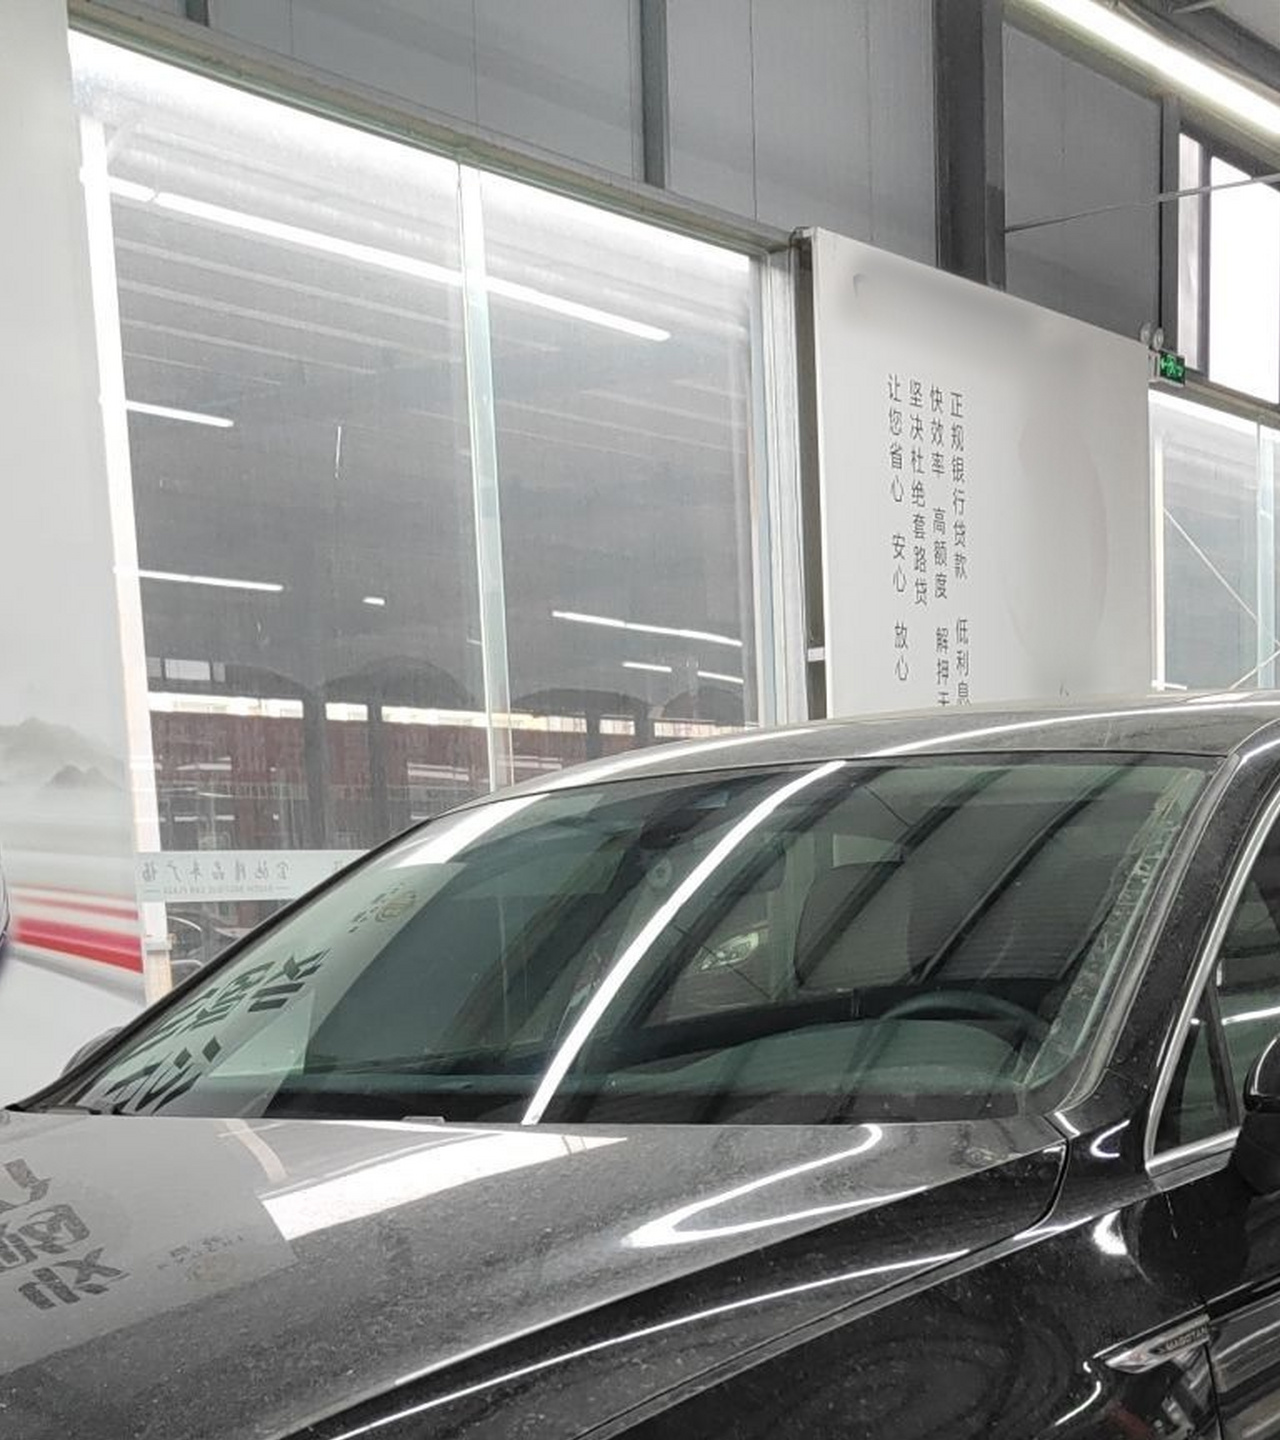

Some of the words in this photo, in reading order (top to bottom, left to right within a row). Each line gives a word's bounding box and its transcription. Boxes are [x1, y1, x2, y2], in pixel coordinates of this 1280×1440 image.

[888, 373, 904, 503] 让您省心
[930, 384, 945, 479] 快效率
[909, 379, 927, 607] 坚决杜绝套路贷
[950, 391, 968, 580] 正规银行贷款
[893, 533, 907, 593] 安心
[933, 506, 948, 600] 高额度
[895, 619, 909, 682] 放心
